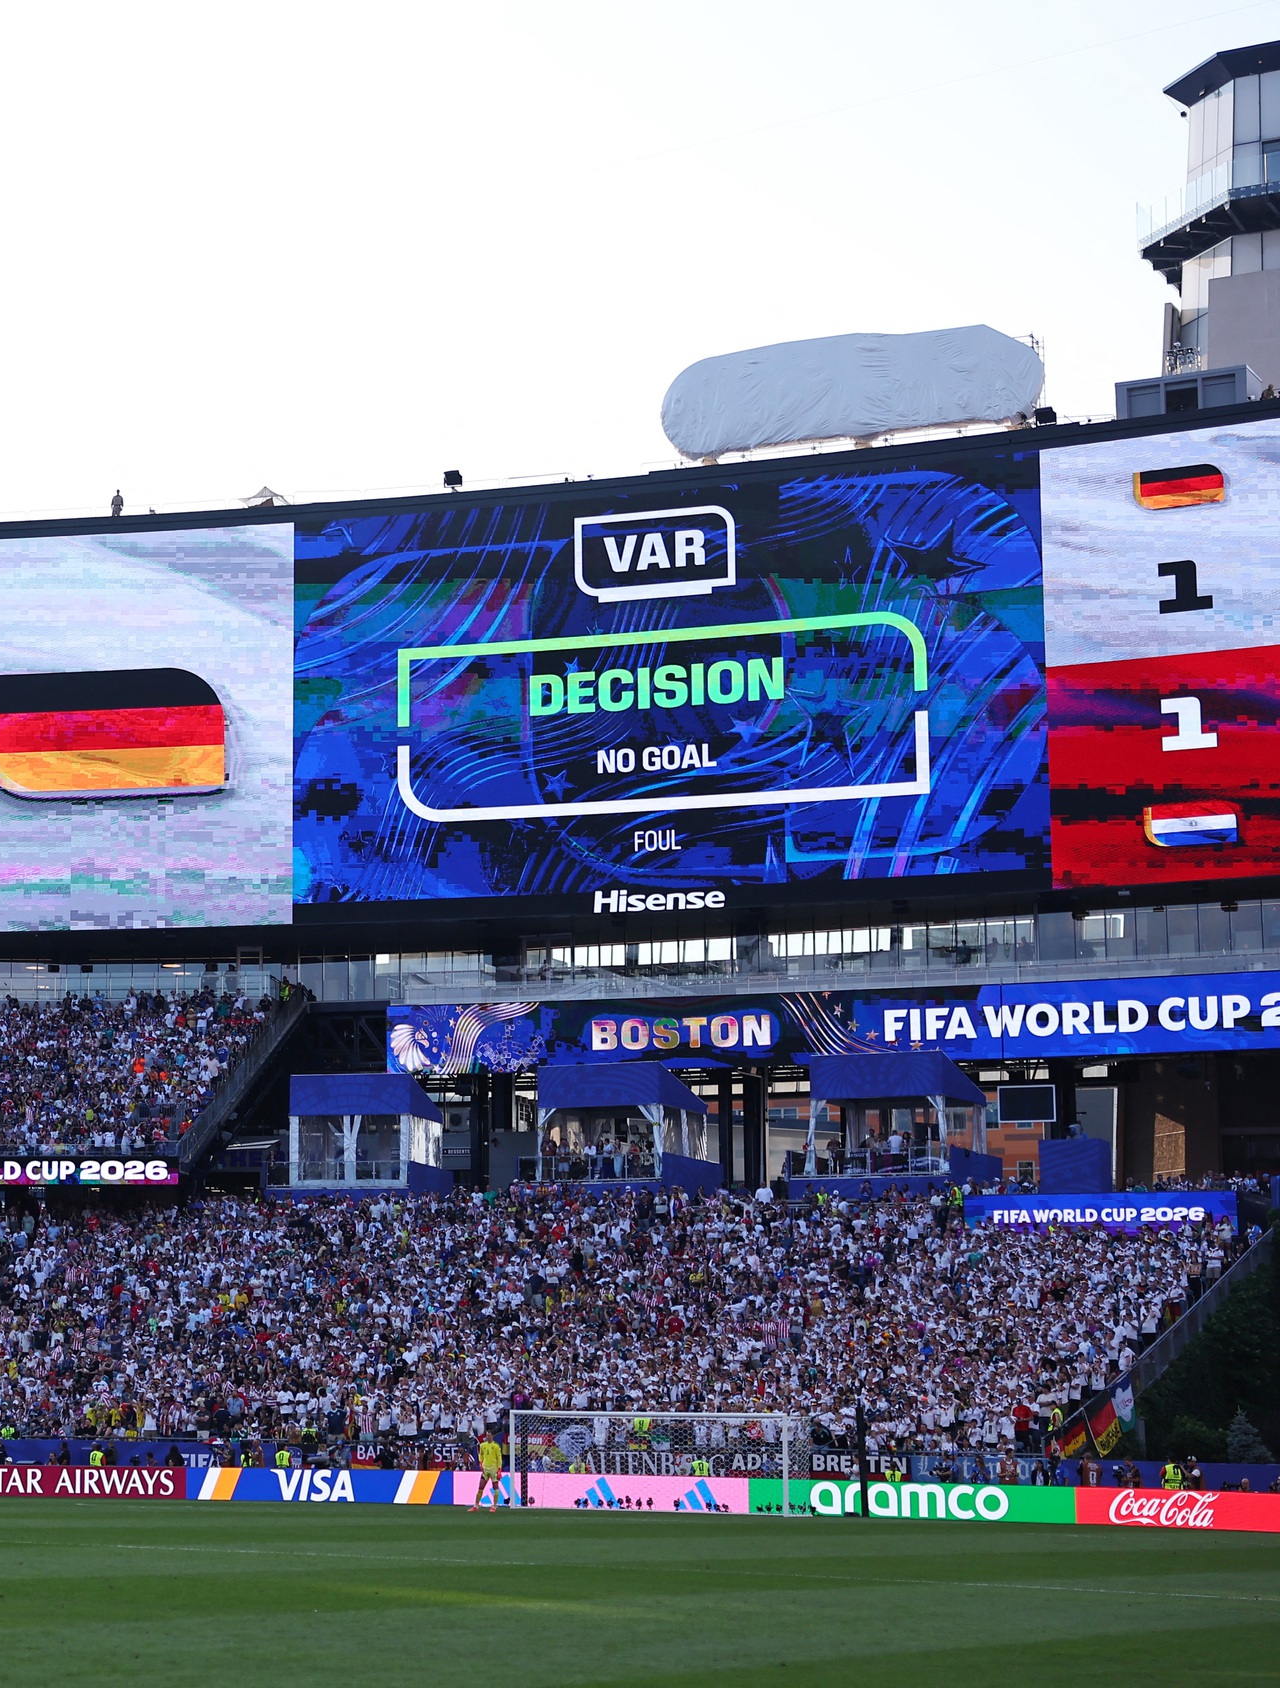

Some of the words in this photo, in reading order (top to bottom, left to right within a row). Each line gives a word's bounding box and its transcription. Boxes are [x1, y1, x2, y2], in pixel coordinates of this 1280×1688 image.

[603, 529, 706, 573] VAR
[1157, 560, 1214, 615] 1
[529, 656, 785, 717] DECISION
[1160, 696, 1218, 752] 1
[597, 748, 636, 774] NO
[642, 743, 717, 771] GOAL
[634, 829, 682, 852] FOUL
[593, 889, 726, 914] Hisense
[591, 1014, 771, 1051] BOSTON
[884, 1007, 977, 1042] FIFA
[982, 999, 1149, 1038] WORLD
[1158, 994, 1251, 1031] CUP
[25, 1160, 76, 1181] CUP
[79, 1160, 168, 1181] 2026
[993, 1210, 1031, 1224] FIFA
[1033, 1209, 1098, 1223] WORLD
[1101, 1208, 1138, 1222] CUP
[1141, 1207, 1205, 1221] 2026
[812, 1454, 907, 1475] BRETEN
[54, 1468, 174, 1496] AIRWAYS
[270, 1469, 355, 1502] VISA
[810, 1481, 1009, 1520] aramco
[1108, 1489, 1220, 1527] Coca-Cola
